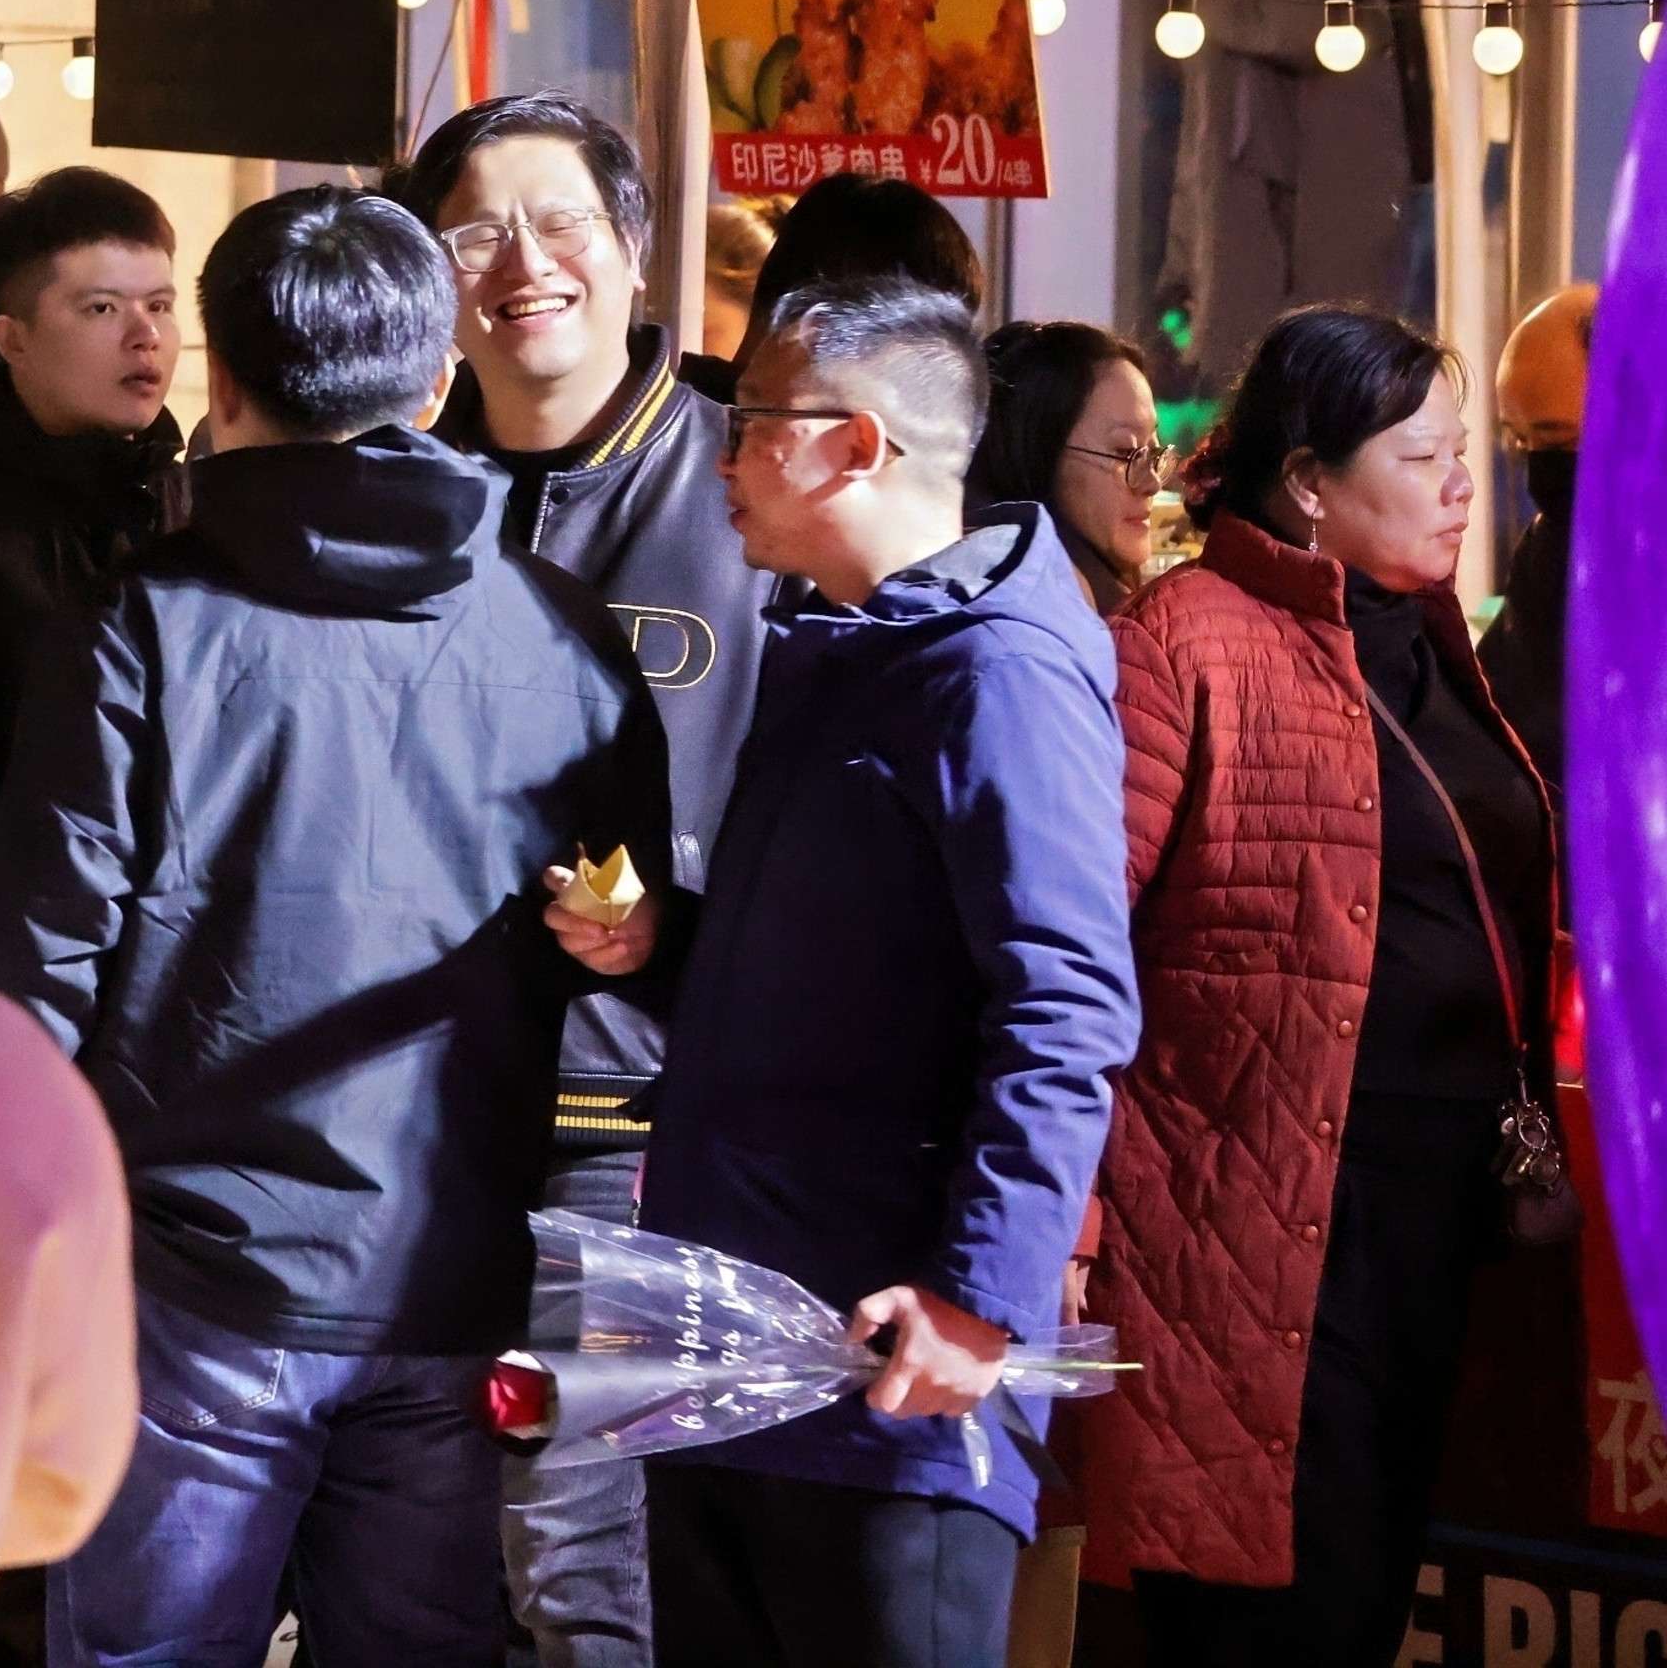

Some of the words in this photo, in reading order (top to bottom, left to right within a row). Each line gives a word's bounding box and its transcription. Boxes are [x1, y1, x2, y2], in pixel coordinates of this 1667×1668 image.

[730, 141, 908, 187] 印尼沙爹肉串
